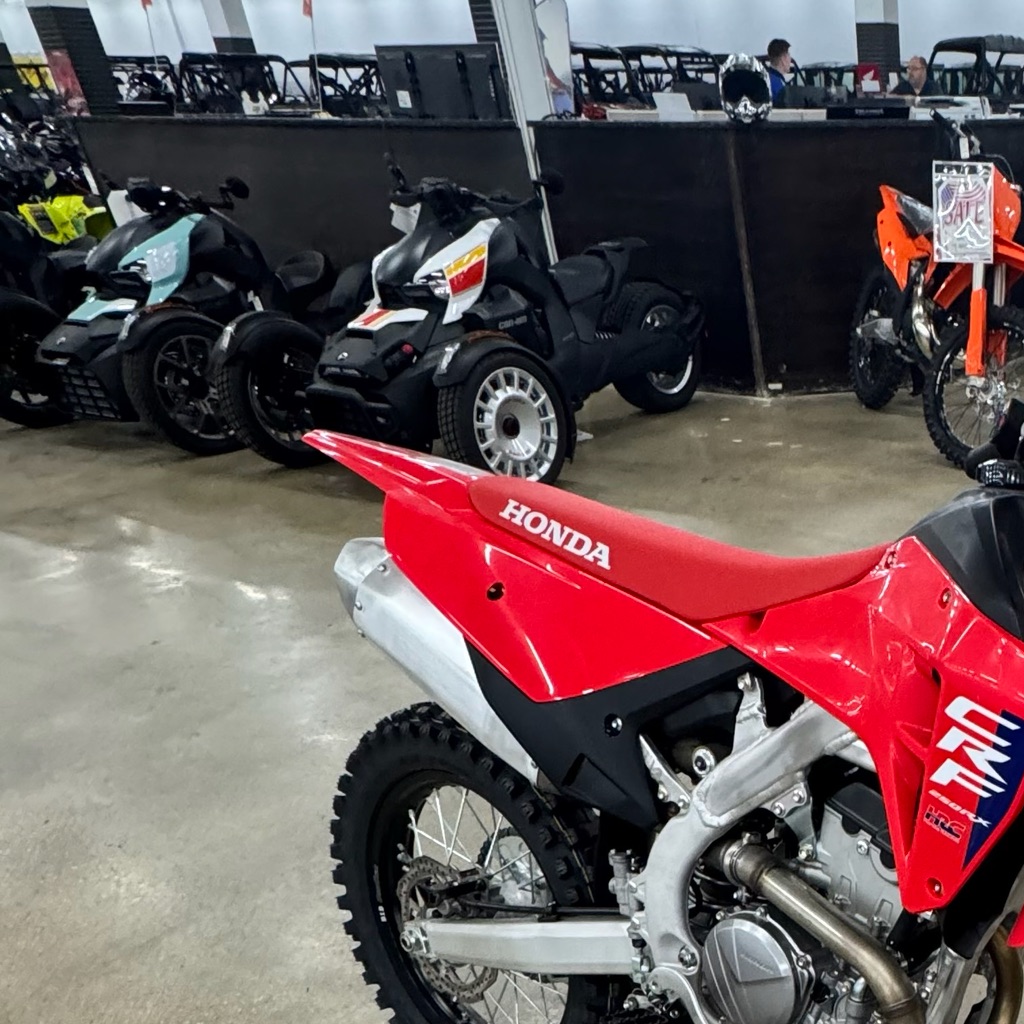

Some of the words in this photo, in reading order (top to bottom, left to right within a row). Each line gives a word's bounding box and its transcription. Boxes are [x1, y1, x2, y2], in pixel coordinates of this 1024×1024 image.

[498, 498, 611, 571] HONDA
[929, 695, 1021, 798] CRF
[923, 805, 966, 839] HRC
